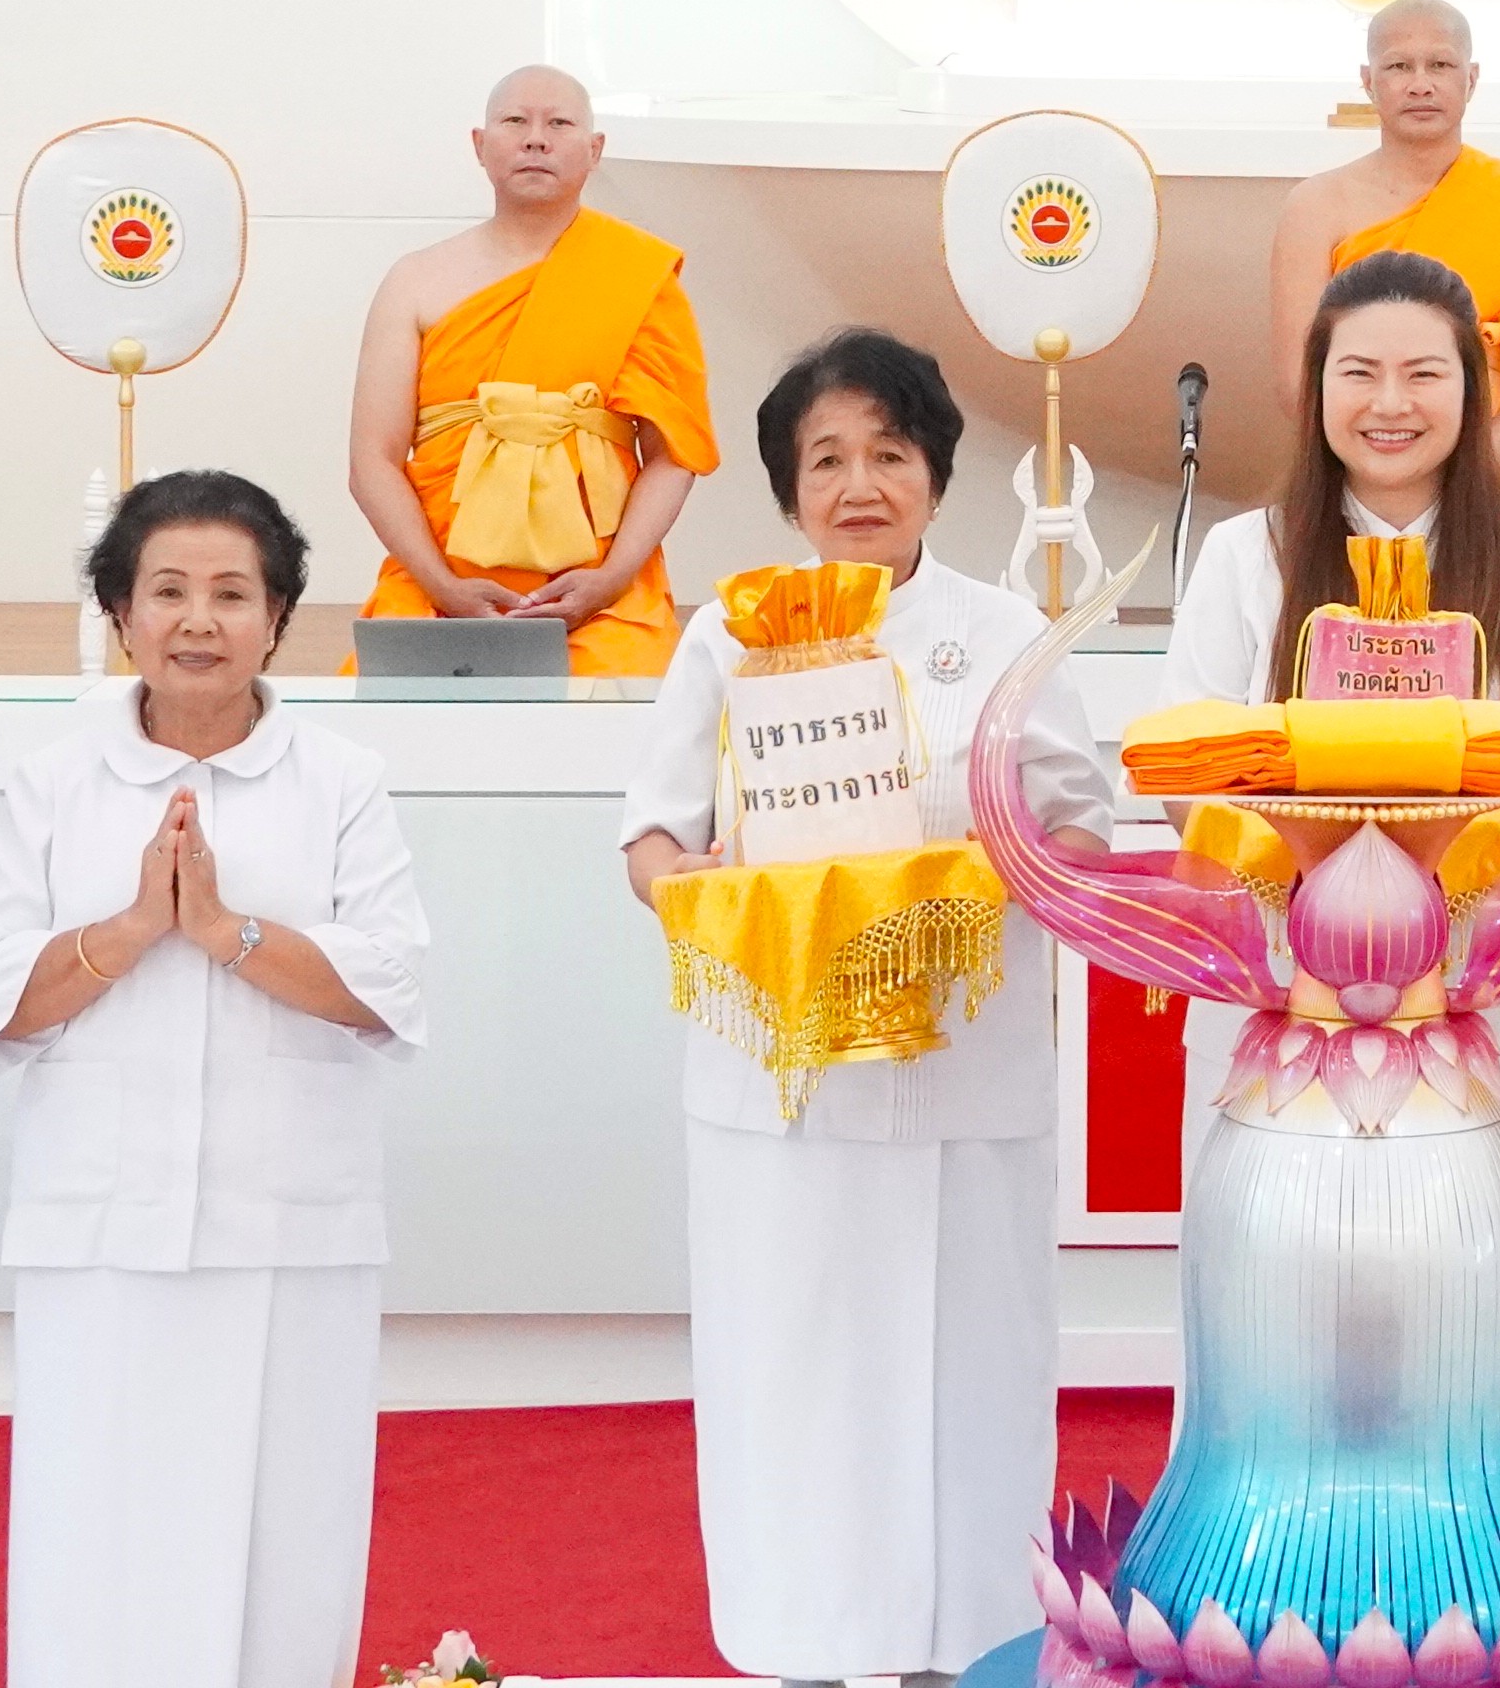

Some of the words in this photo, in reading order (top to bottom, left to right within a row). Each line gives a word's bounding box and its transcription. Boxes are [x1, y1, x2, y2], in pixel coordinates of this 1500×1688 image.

[1347, 632, 1436, 656] ประธาน
[1336, 666, 1444, 693] ทอดผ้าป่า
[746, 707, 888, 760] บูชาธรรม
[741, 750, 910, 812] พระอาจารย์
